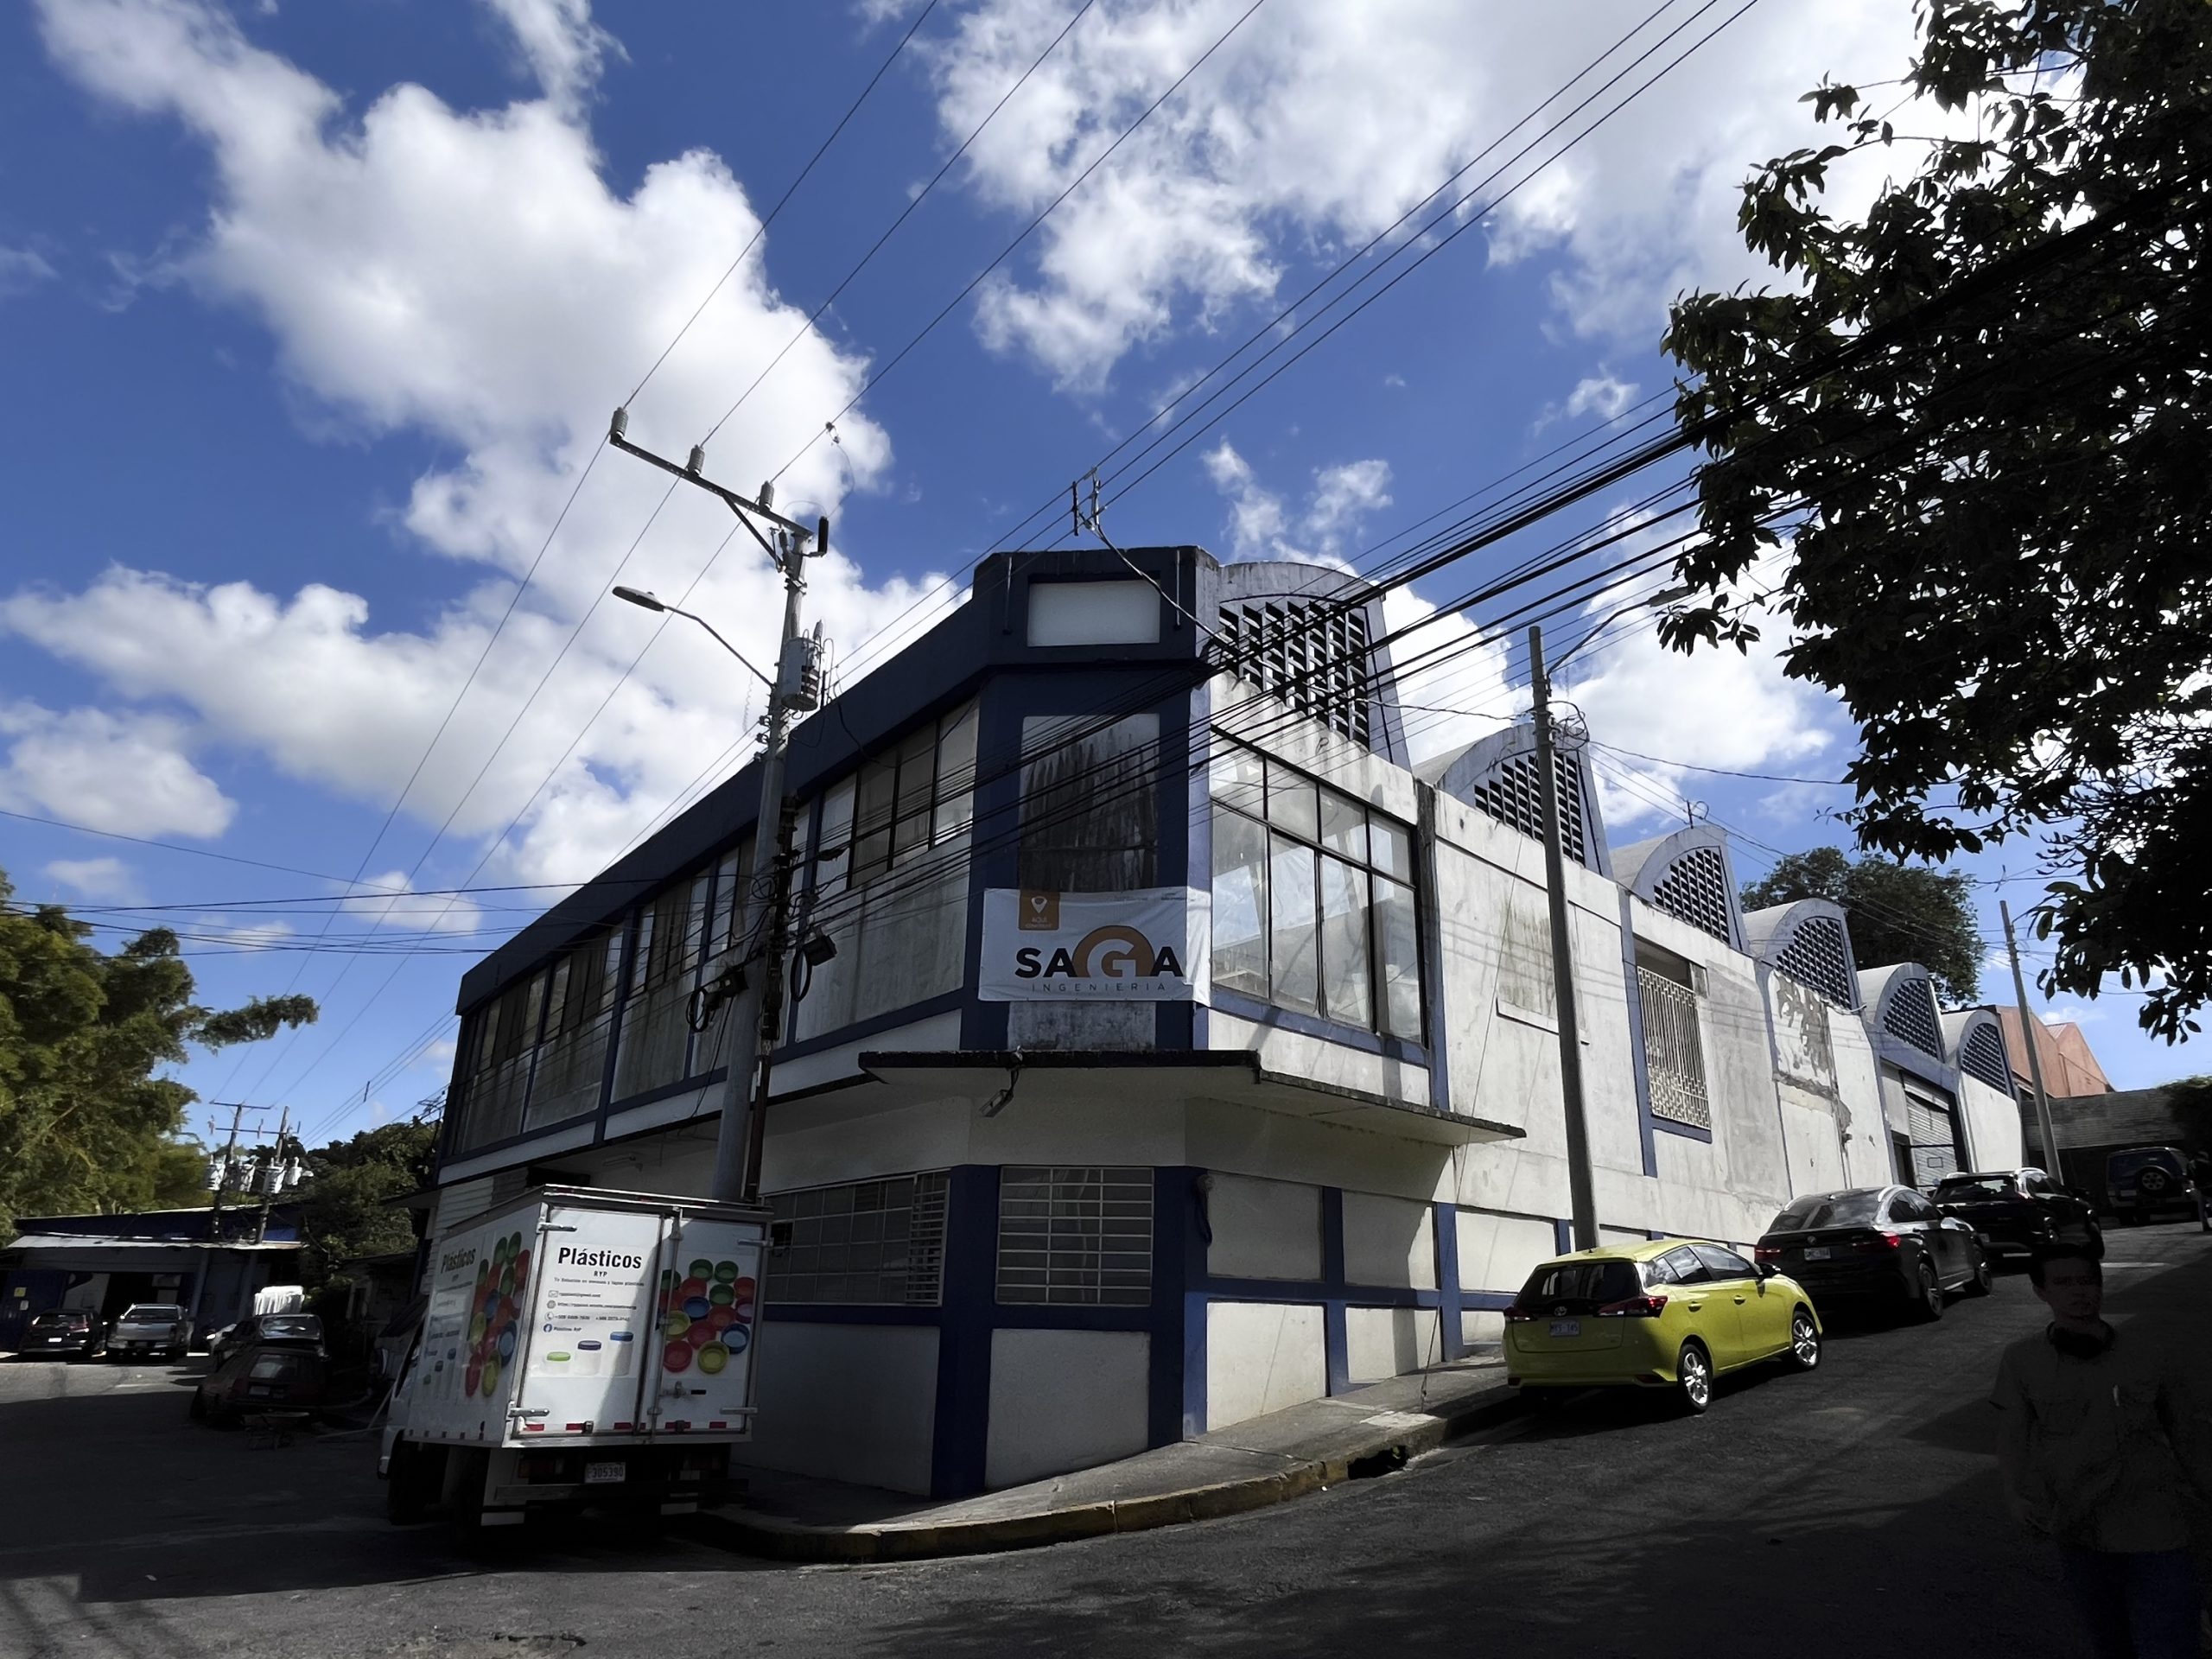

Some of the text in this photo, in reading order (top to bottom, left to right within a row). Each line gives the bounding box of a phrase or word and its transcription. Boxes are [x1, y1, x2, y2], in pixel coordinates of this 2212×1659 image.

[1014, 925, 1184, 978] SAGA
[1032, 982, 1166, 992] INGENIERIA
[557, 1247, 643, 1269] Plásticos
